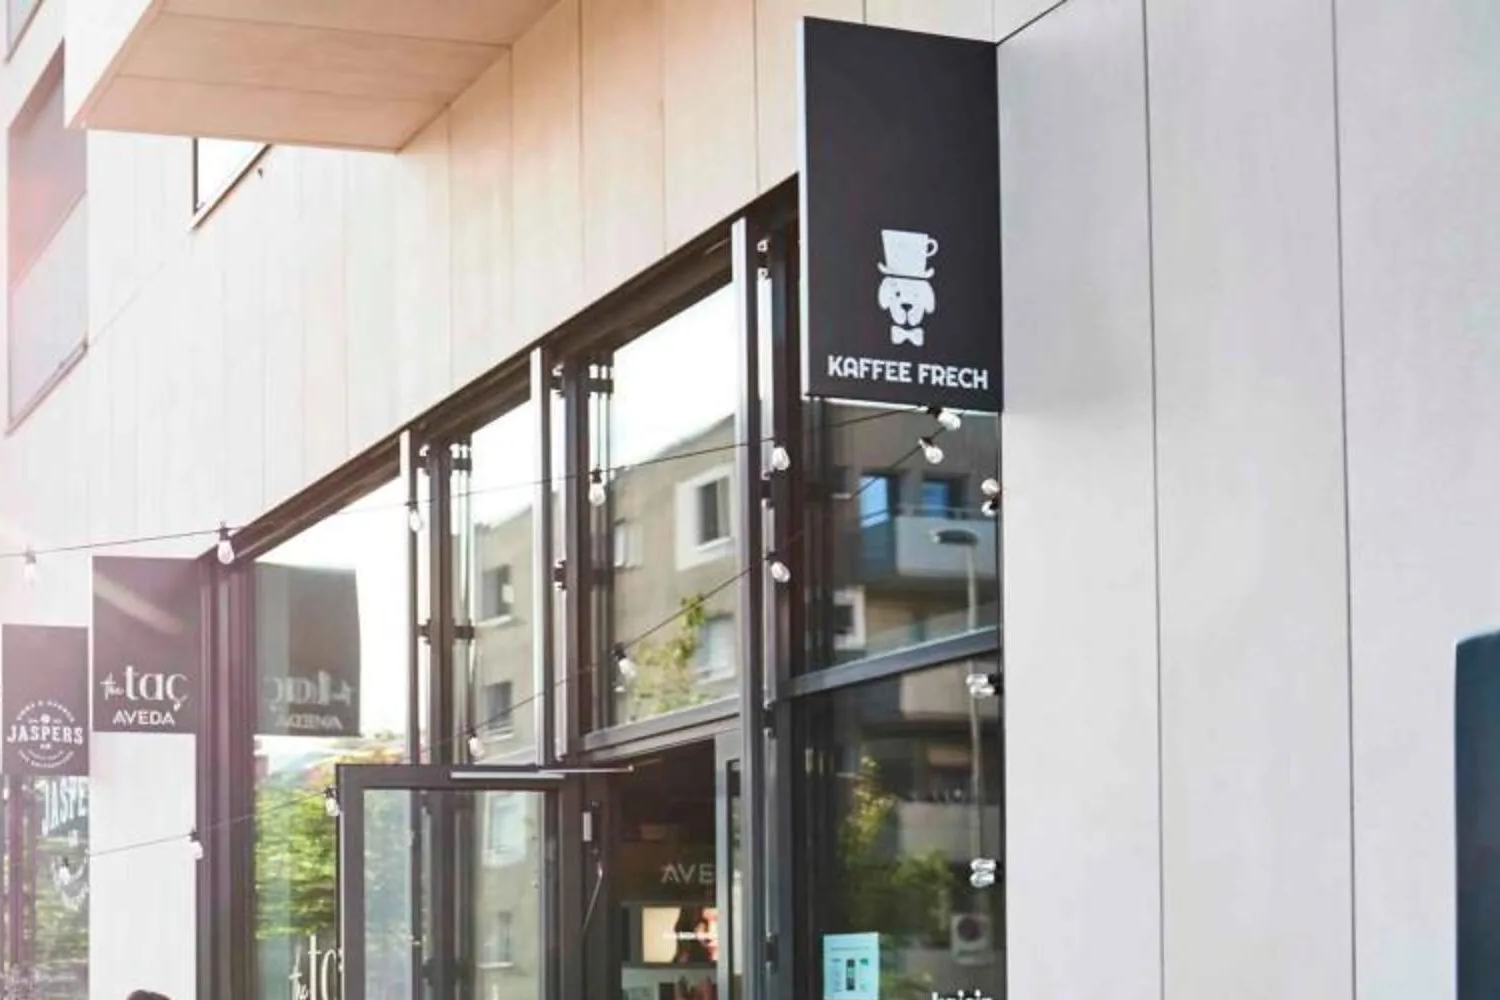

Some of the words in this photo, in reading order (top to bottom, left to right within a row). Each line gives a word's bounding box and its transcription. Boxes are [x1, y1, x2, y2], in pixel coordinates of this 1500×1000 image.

[827, 354, 912, 383] KAFFEE
[917, 362, 989, 390] FRECH
[112, 709, 176, 726] AVEDA
[6, 724, 85, 745] JASPERS
[34, 776, 88, 836] JASPE
[661, 863, 717, 885] AVE
